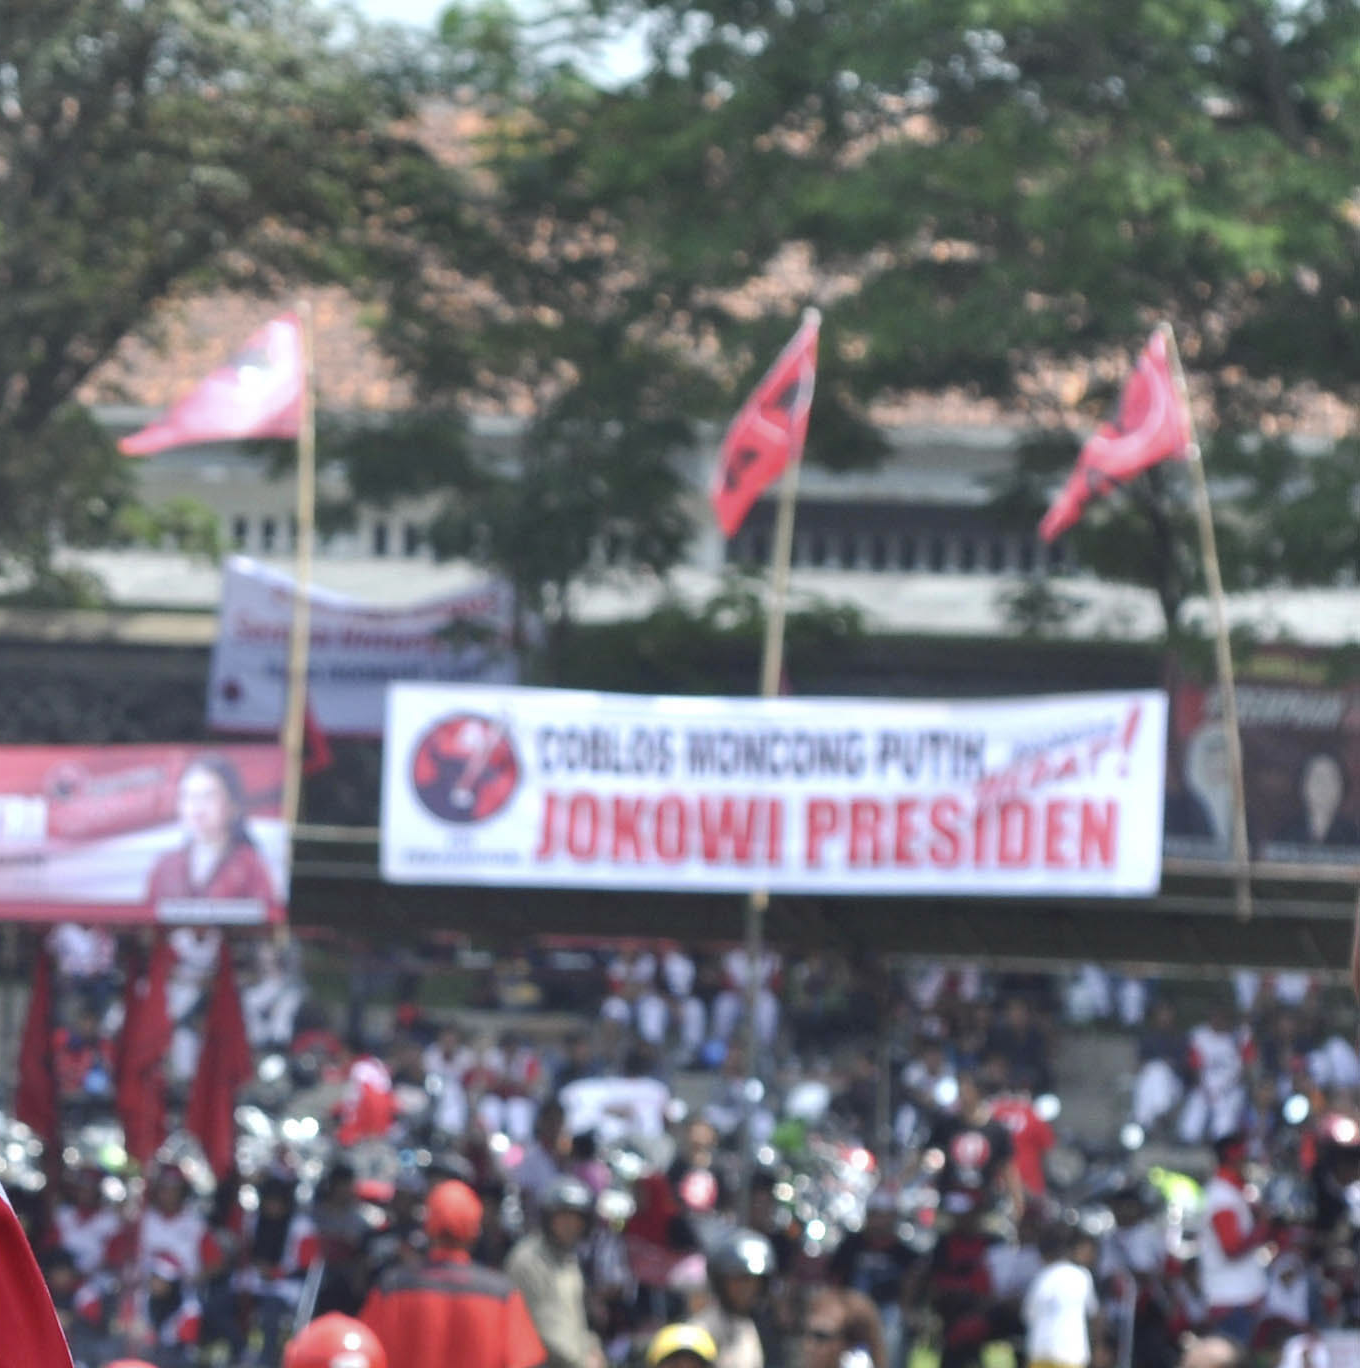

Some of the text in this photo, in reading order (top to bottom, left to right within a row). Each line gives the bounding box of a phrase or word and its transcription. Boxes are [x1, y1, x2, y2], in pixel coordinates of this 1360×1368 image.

[537, 722, 673, 775] COBLOS
[534, 790, 1120, 871] JOKOWI PRESIDEN
